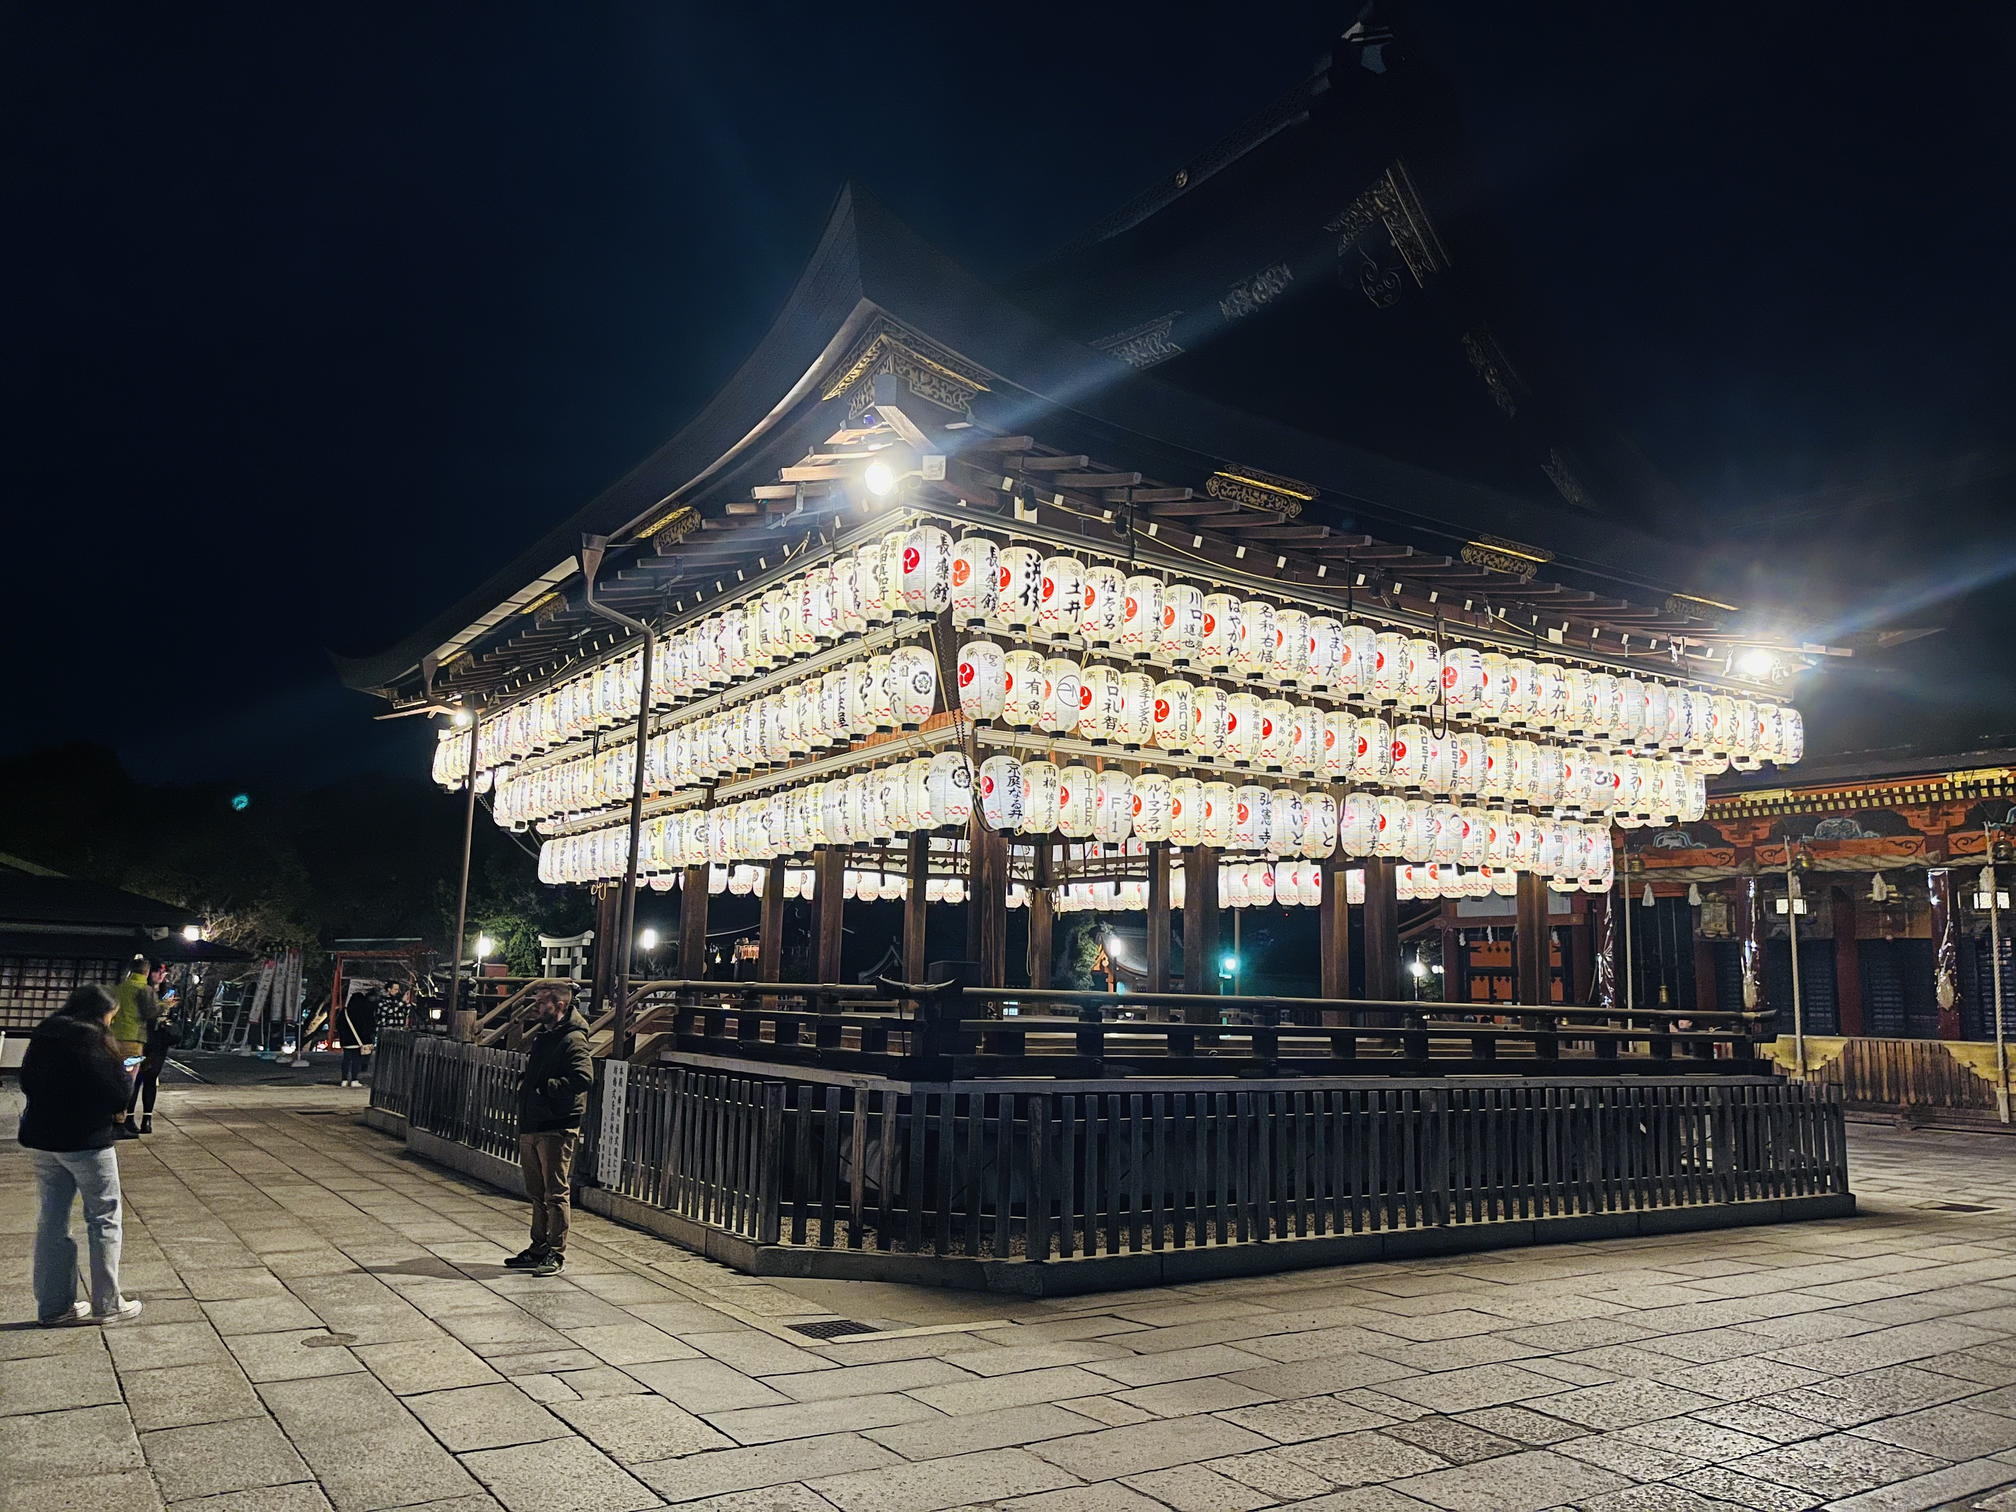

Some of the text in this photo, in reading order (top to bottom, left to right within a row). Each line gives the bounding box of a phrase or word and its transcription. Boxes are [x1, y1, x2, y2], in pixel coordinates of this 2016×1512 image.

[1063, 577, 1081, 623] 土井
[1188, 591, 1204, 620] 川口
[1226, 598, 1241, 658] はやかわ
[1326, 622, 1342, 678] やました
[1025, 655, 1042, 717] 慶有魚
[1424, 644, 1439, 696] 里奈
[1550, 667, 1566, 719] 山加代
[1101, 669, 1120, 731] 関口礼智
[1176, 691, 1188, 741] Wands
[1418, 727, 1428, 781] NOSTER
[1449, 731, 1459, 788] NOSTER
[1147, 779, 1172, 834] サウナ ルーマプラザ
[1290, 795, 1304, 846] おいと
[1321, 797, 1336, 848] おいと
